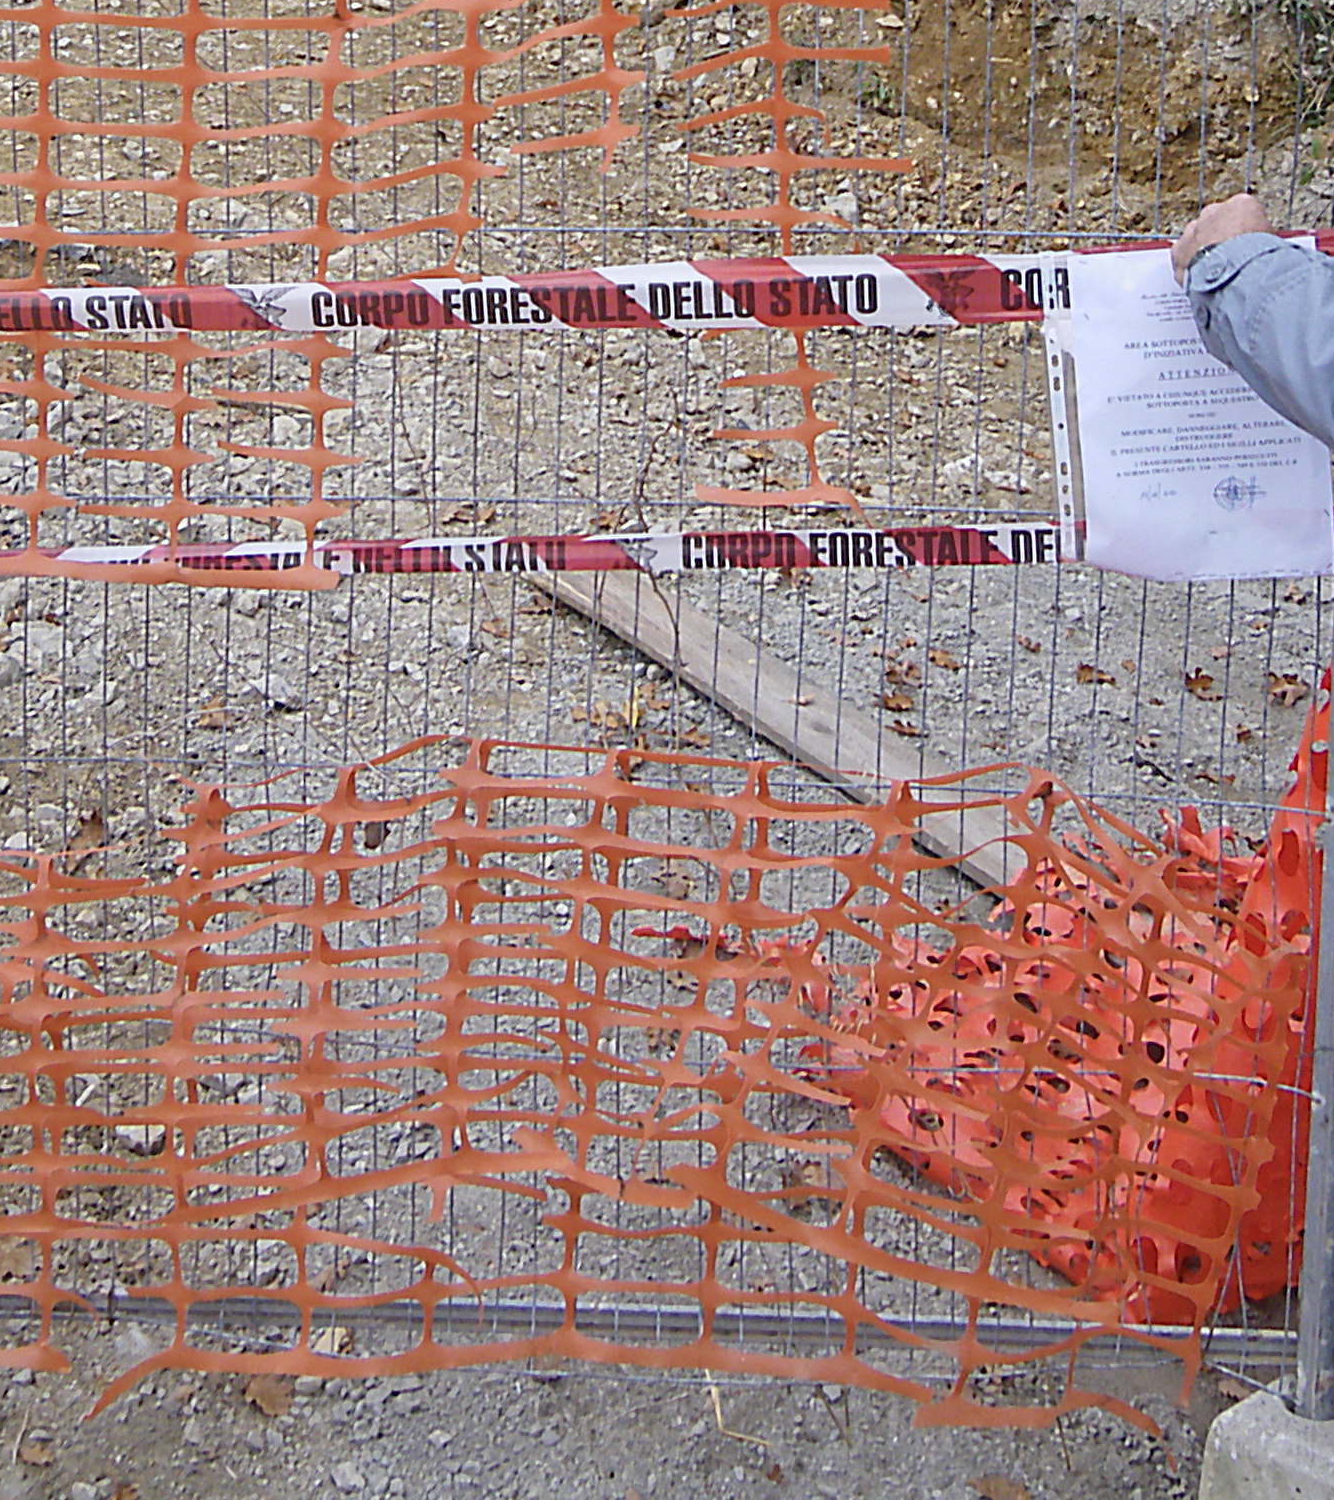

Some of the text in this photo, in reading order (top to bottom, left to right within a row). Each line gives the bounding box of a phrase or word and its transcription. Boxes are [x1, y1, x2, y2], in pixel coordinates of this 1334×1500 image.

[86, 293, 193, 330] STATO
[311, 288, 431, 328] CORPO
[441, 282, 636, 325] FORESTALE
[648, 277, 756, 321] DELLO
[768, 273, 877, 318] STATO
[682, 534, 795, 569] CORPO
[808, 529, 998, 568] FORESTALE
